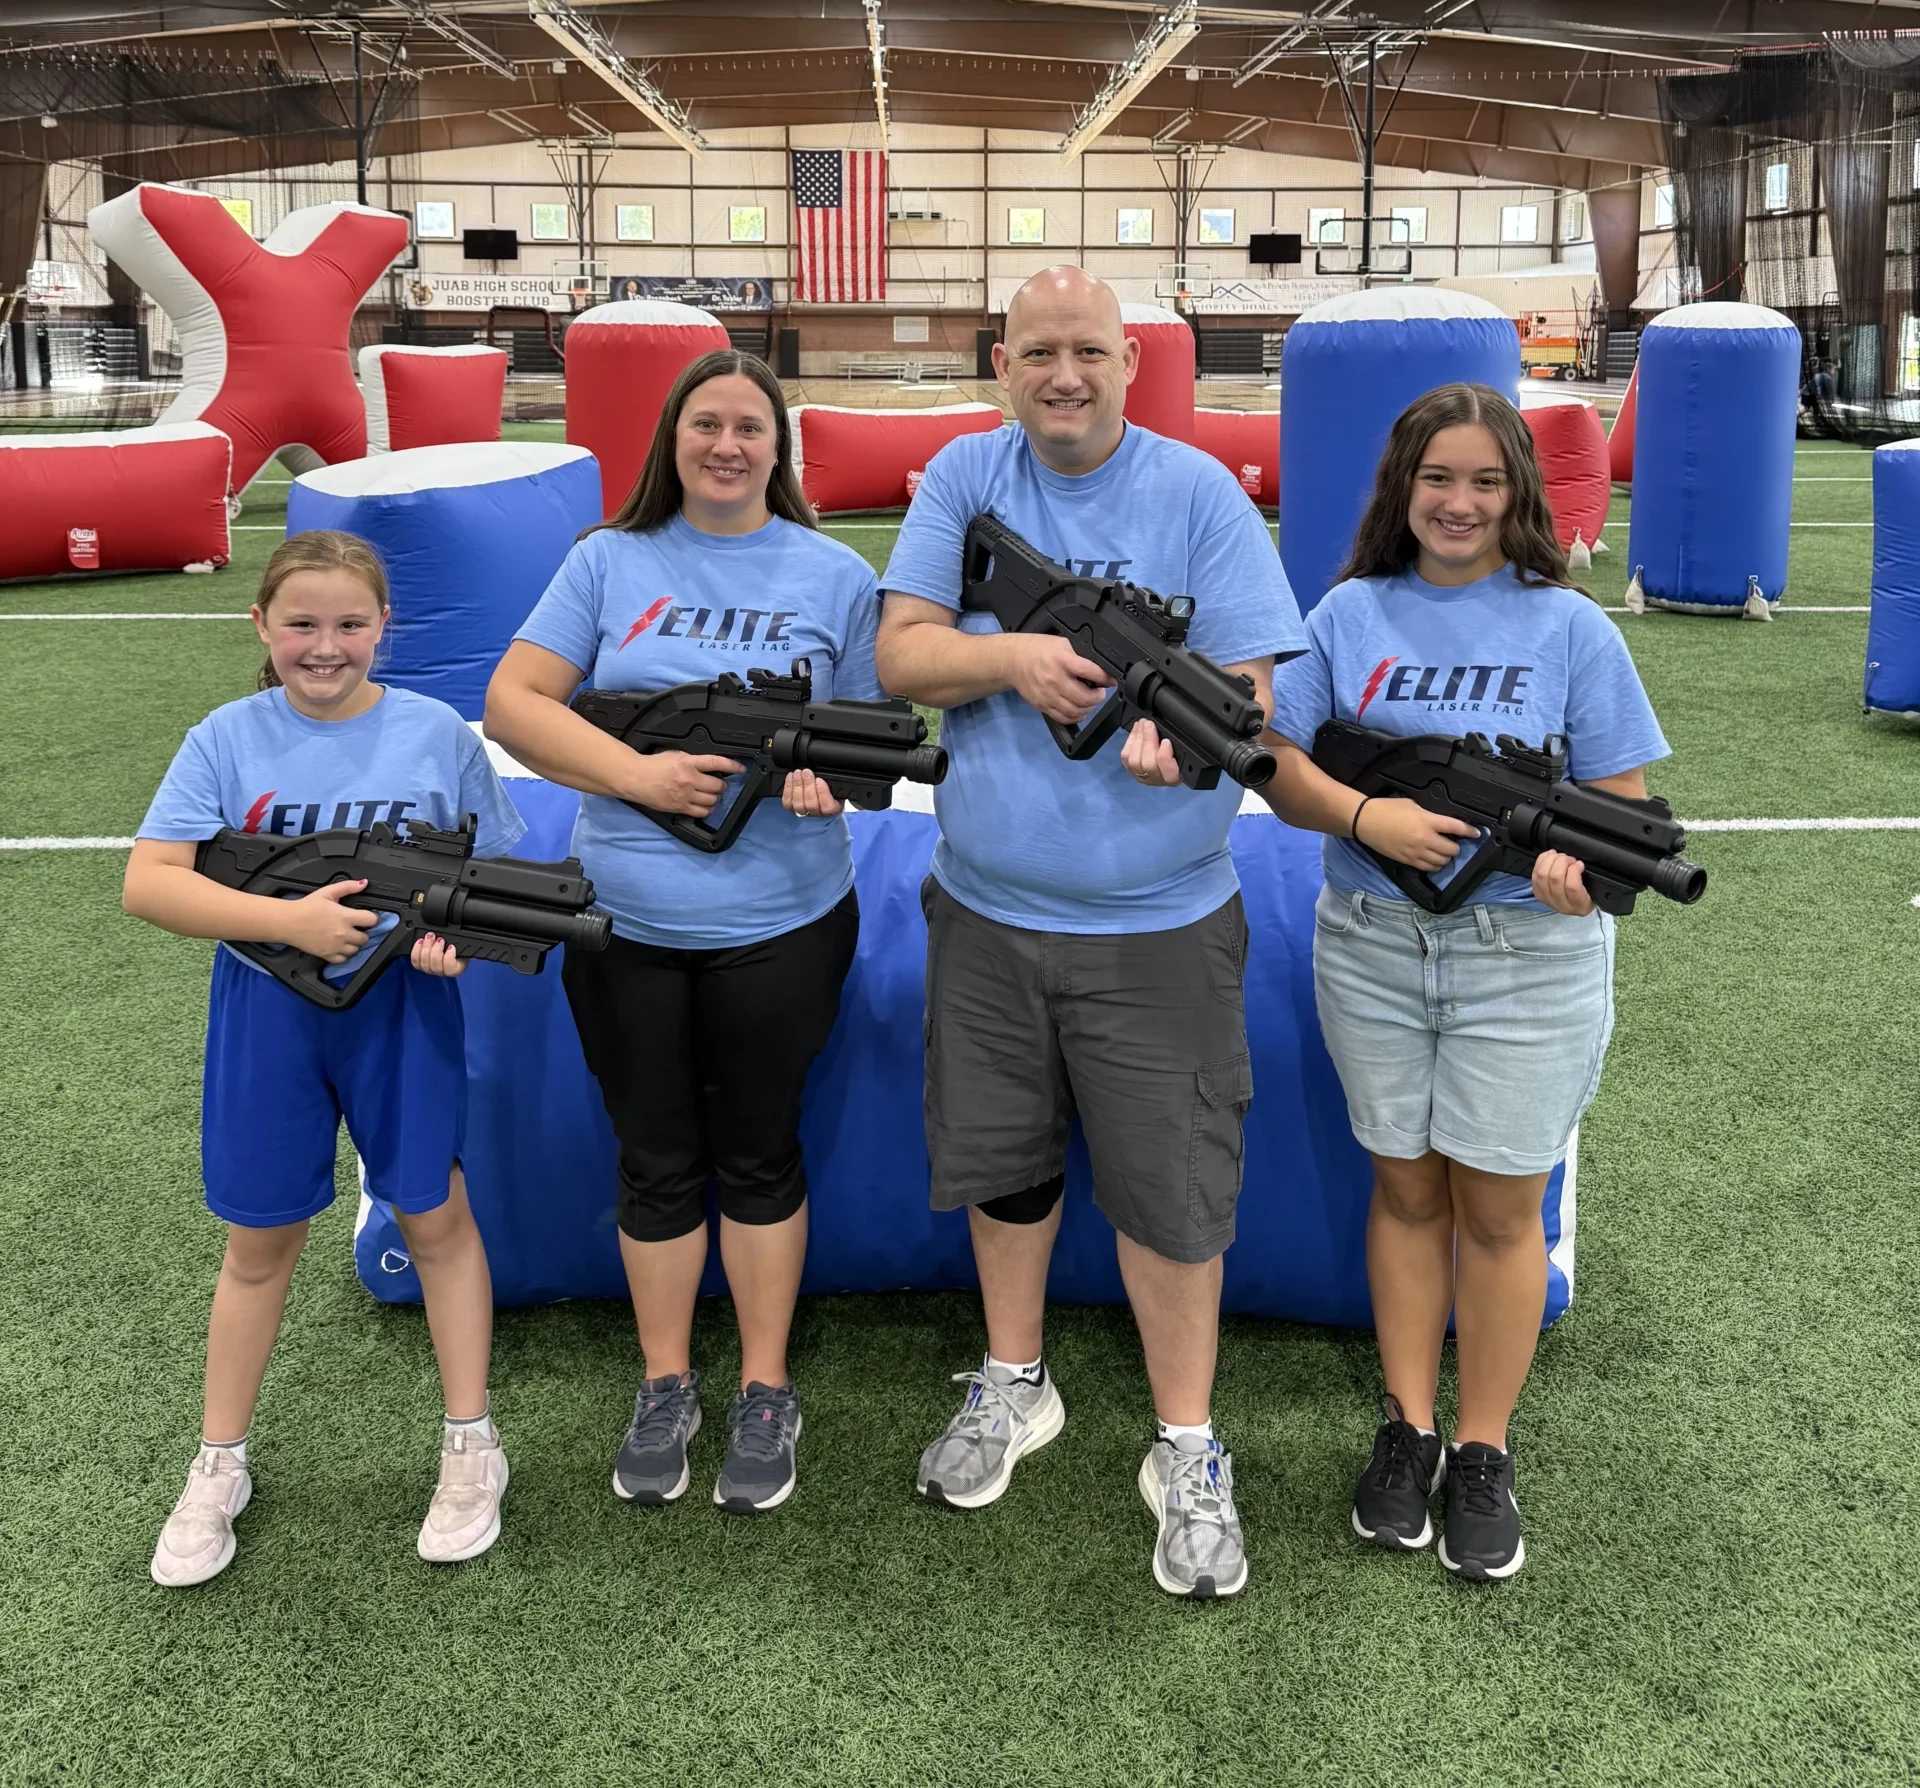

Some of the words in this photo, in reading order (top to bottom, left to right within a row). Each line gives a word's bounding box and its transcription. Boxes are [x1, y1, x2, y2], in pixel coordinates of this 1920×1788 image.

[431, 280, 470, 291] JUAB
[474, 281, 507, 292] HIGH
[446, 295, 509, 306] BOOSTER
[513, 296, 550, 306] CLUB
[657, 606, 799, 643] ELITE
[699, 640, 751, 652] LASER
[761, 642, 790, 652] TAG
[1385, 665, 1534, 705] ELITE
[1427, 702, 1480, 712] LASER
[1491, 703, 1523, 716] TAG
